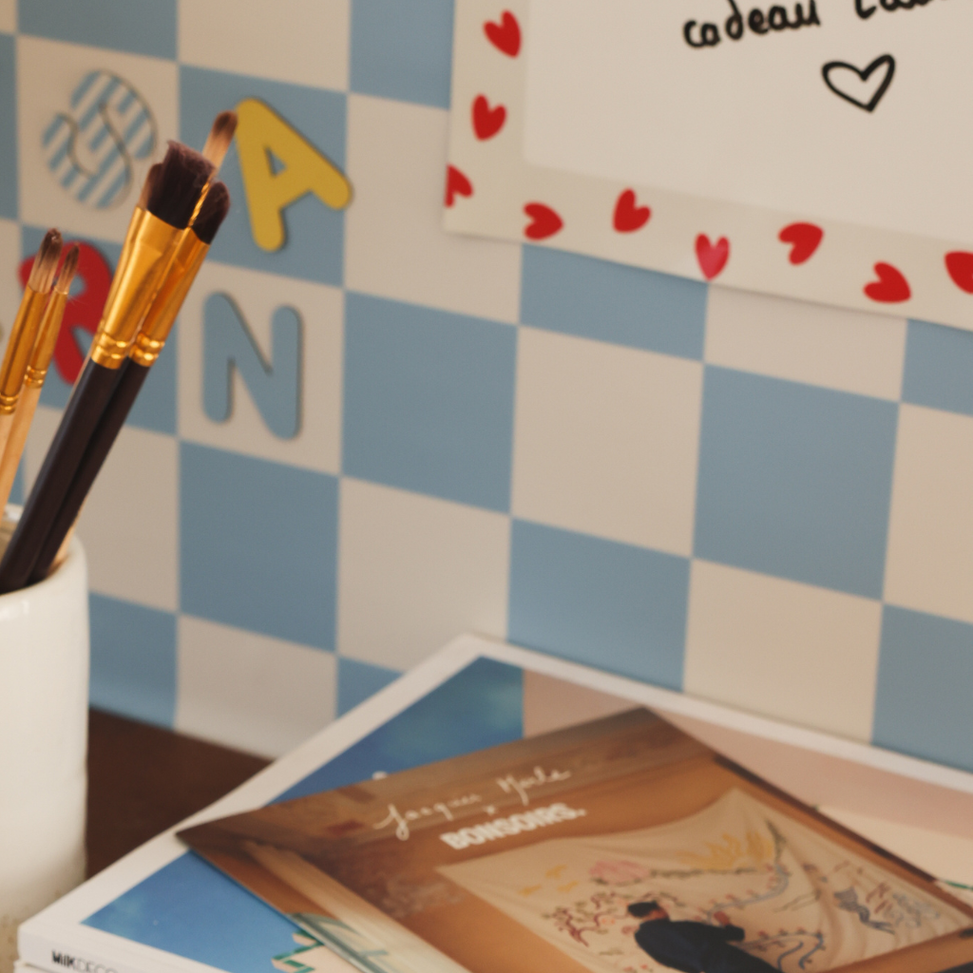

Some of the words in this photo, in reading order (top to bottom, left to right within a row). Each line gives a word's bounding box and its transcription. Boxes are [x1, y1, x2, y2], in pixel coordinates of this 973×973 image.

[683, 0, 821, 49] cadeau
[233, 96, 355, 253] A
[202, 291, 303, 441] N
